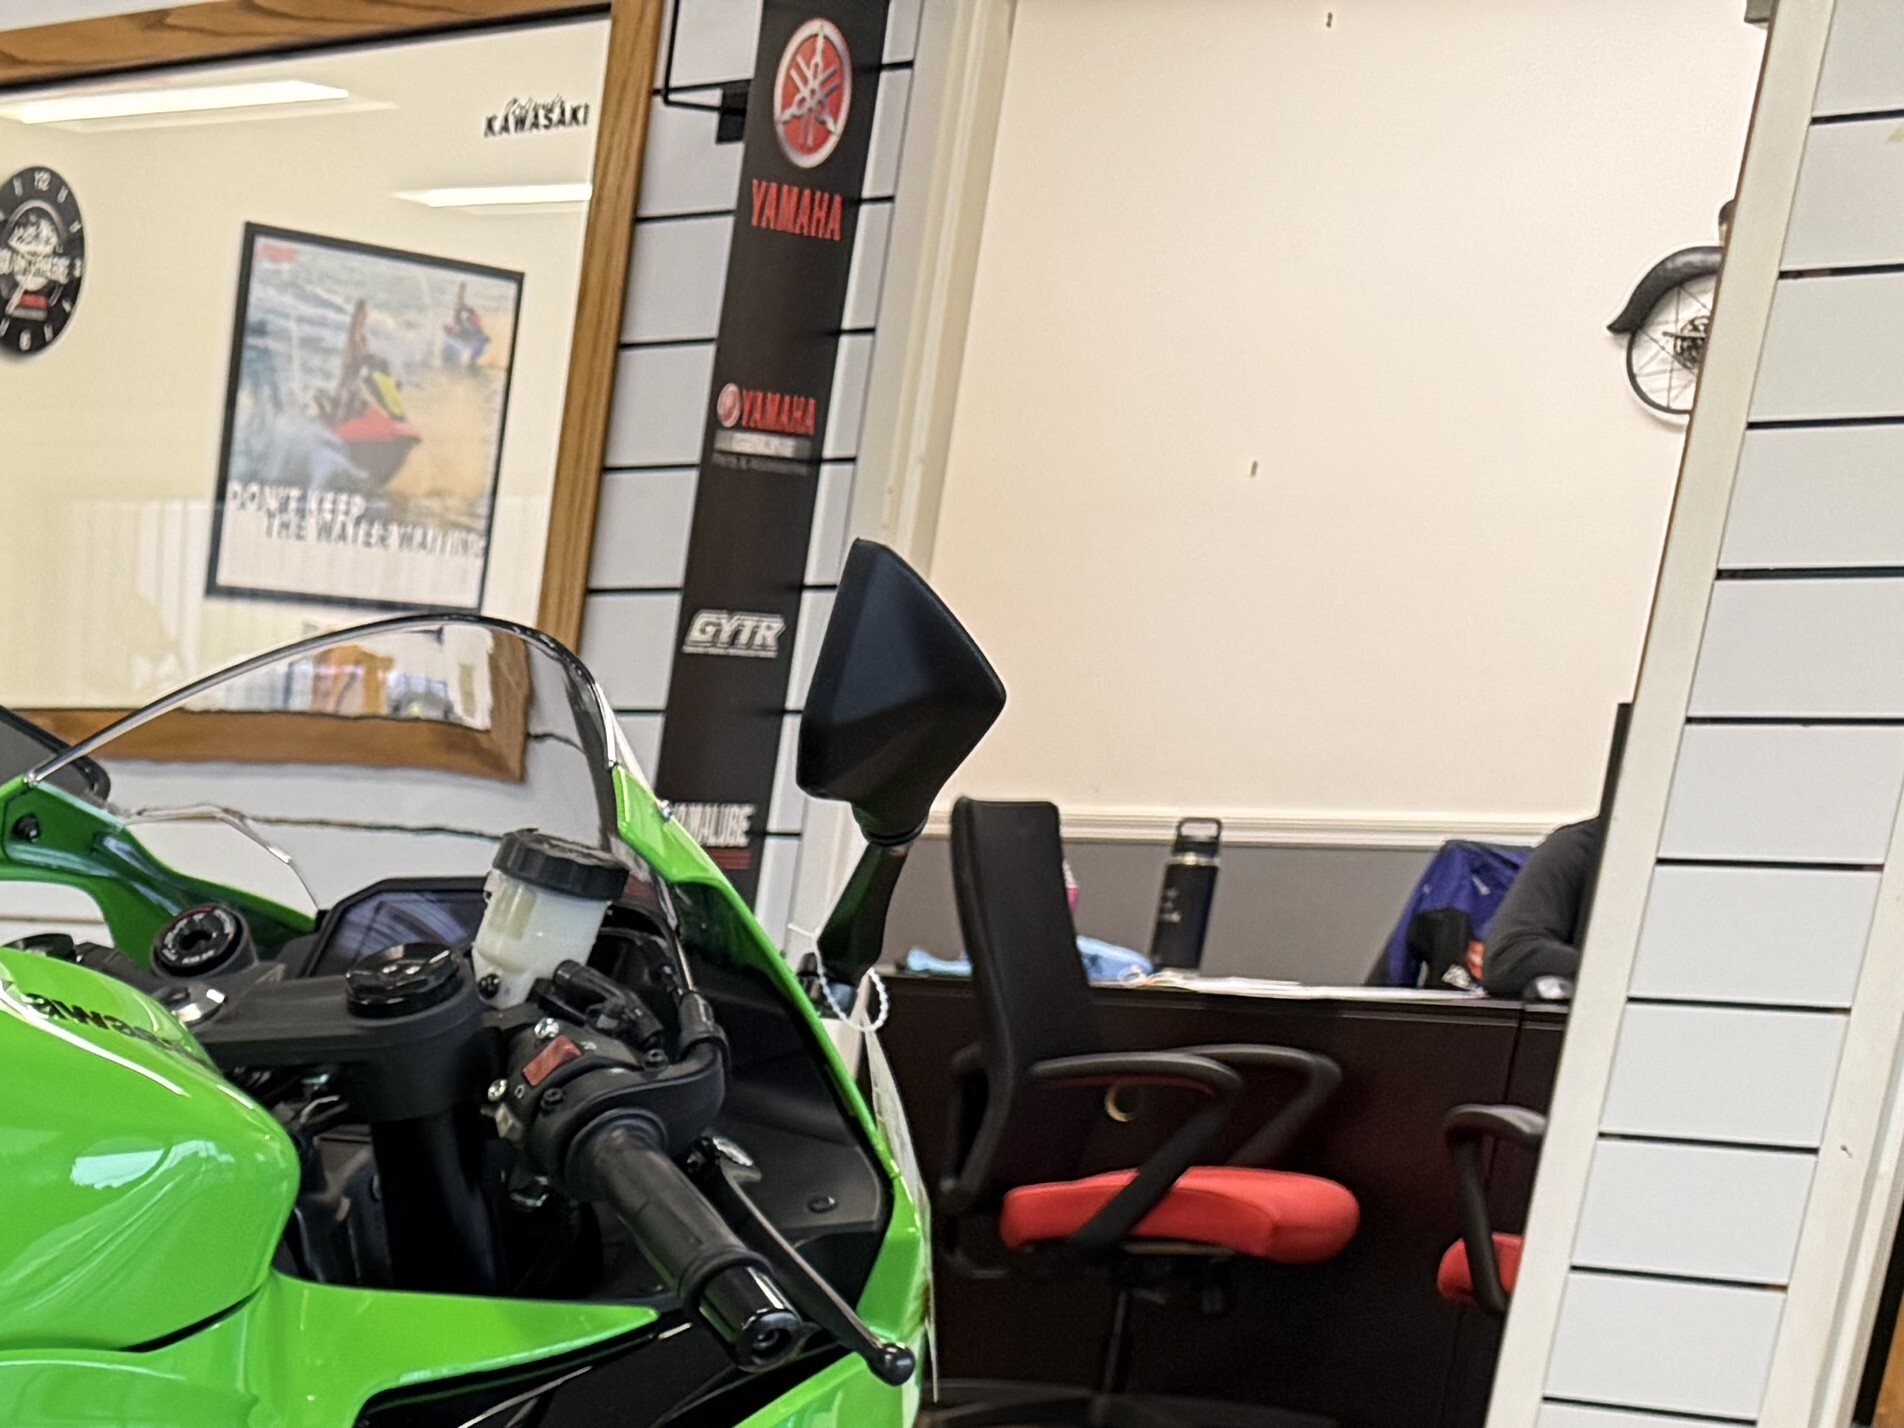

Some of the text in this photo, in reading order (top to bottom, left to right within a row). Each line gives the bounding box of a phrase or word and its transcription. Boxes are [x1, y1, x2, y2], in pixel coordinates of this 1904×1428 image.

[483, 101, 589, 138] KAWASAKI
[752, 179, 843, 242] YAMAHA
[742, 389, 817, 436] YAMAHA
[307, 487, 366, 519] KEEP
[265, 511, 307, 541] THE
[689, 609, 786, 650] GYTR
